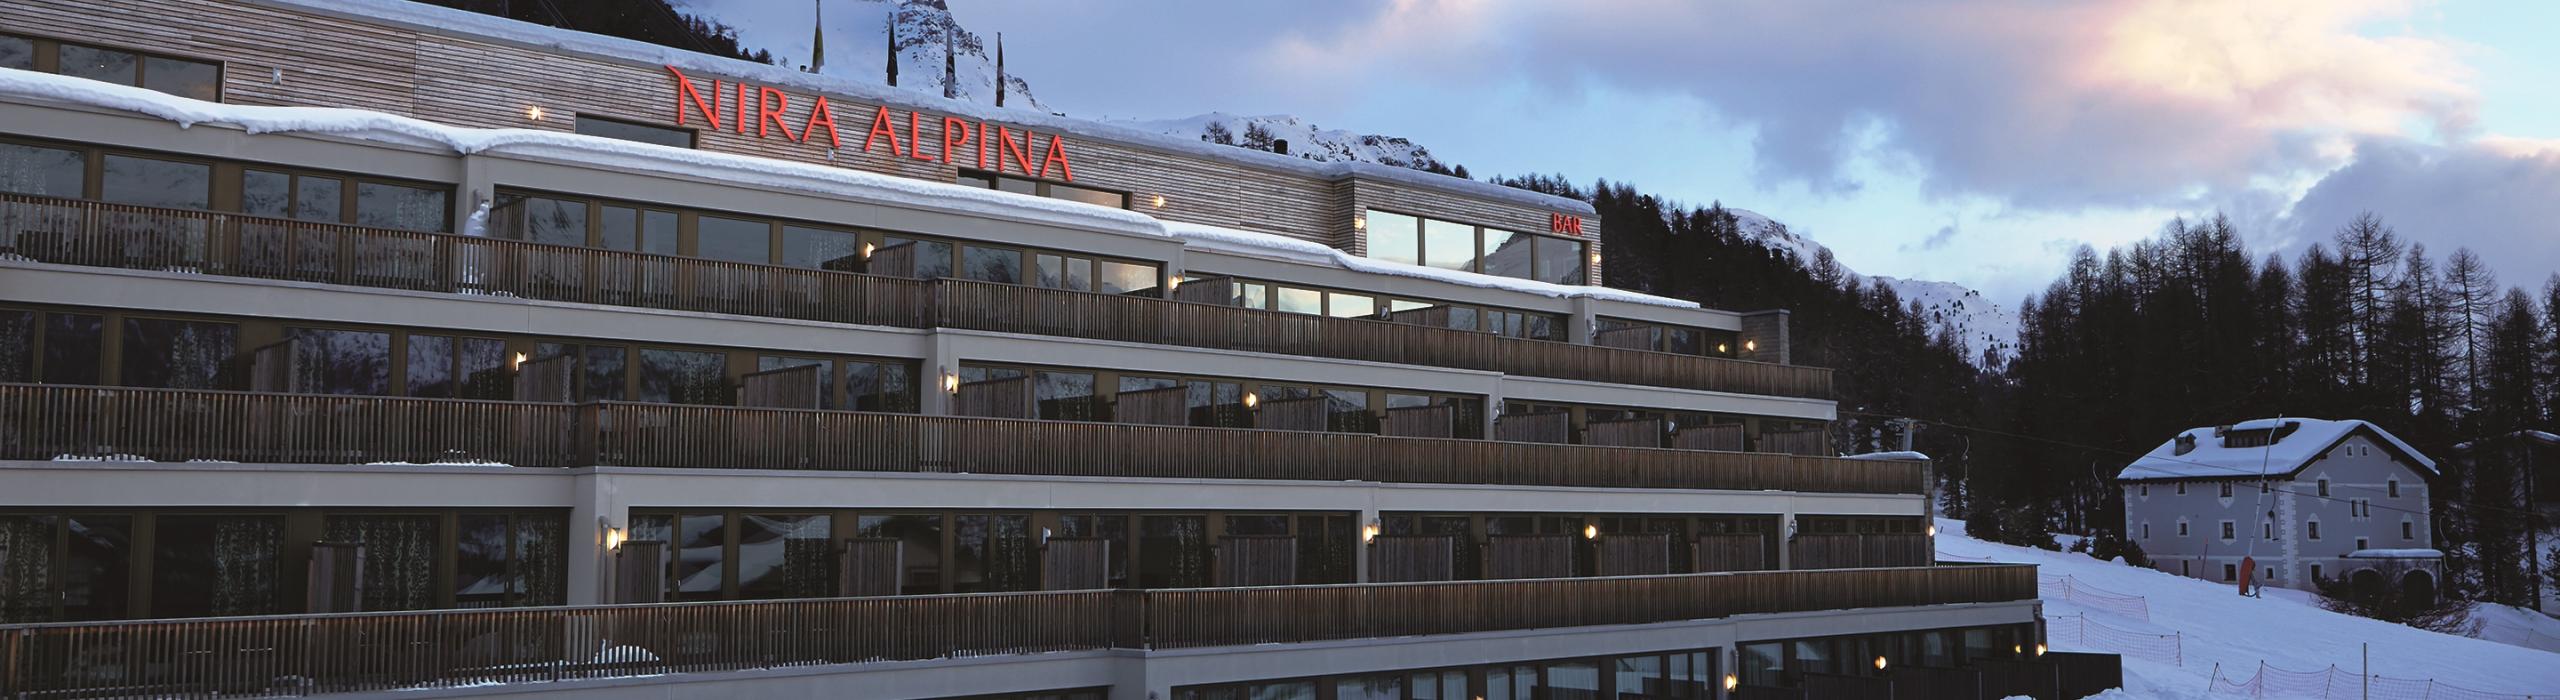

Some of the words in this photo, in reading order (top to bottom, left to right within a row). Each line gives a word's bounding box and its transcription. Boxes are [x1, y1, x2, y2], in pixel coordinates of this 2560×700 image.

[664, 65, 842, 149] NIRA
[864, 106, 1074, 182] ALPINA
[1552, 213, 1583, 235] BAR
